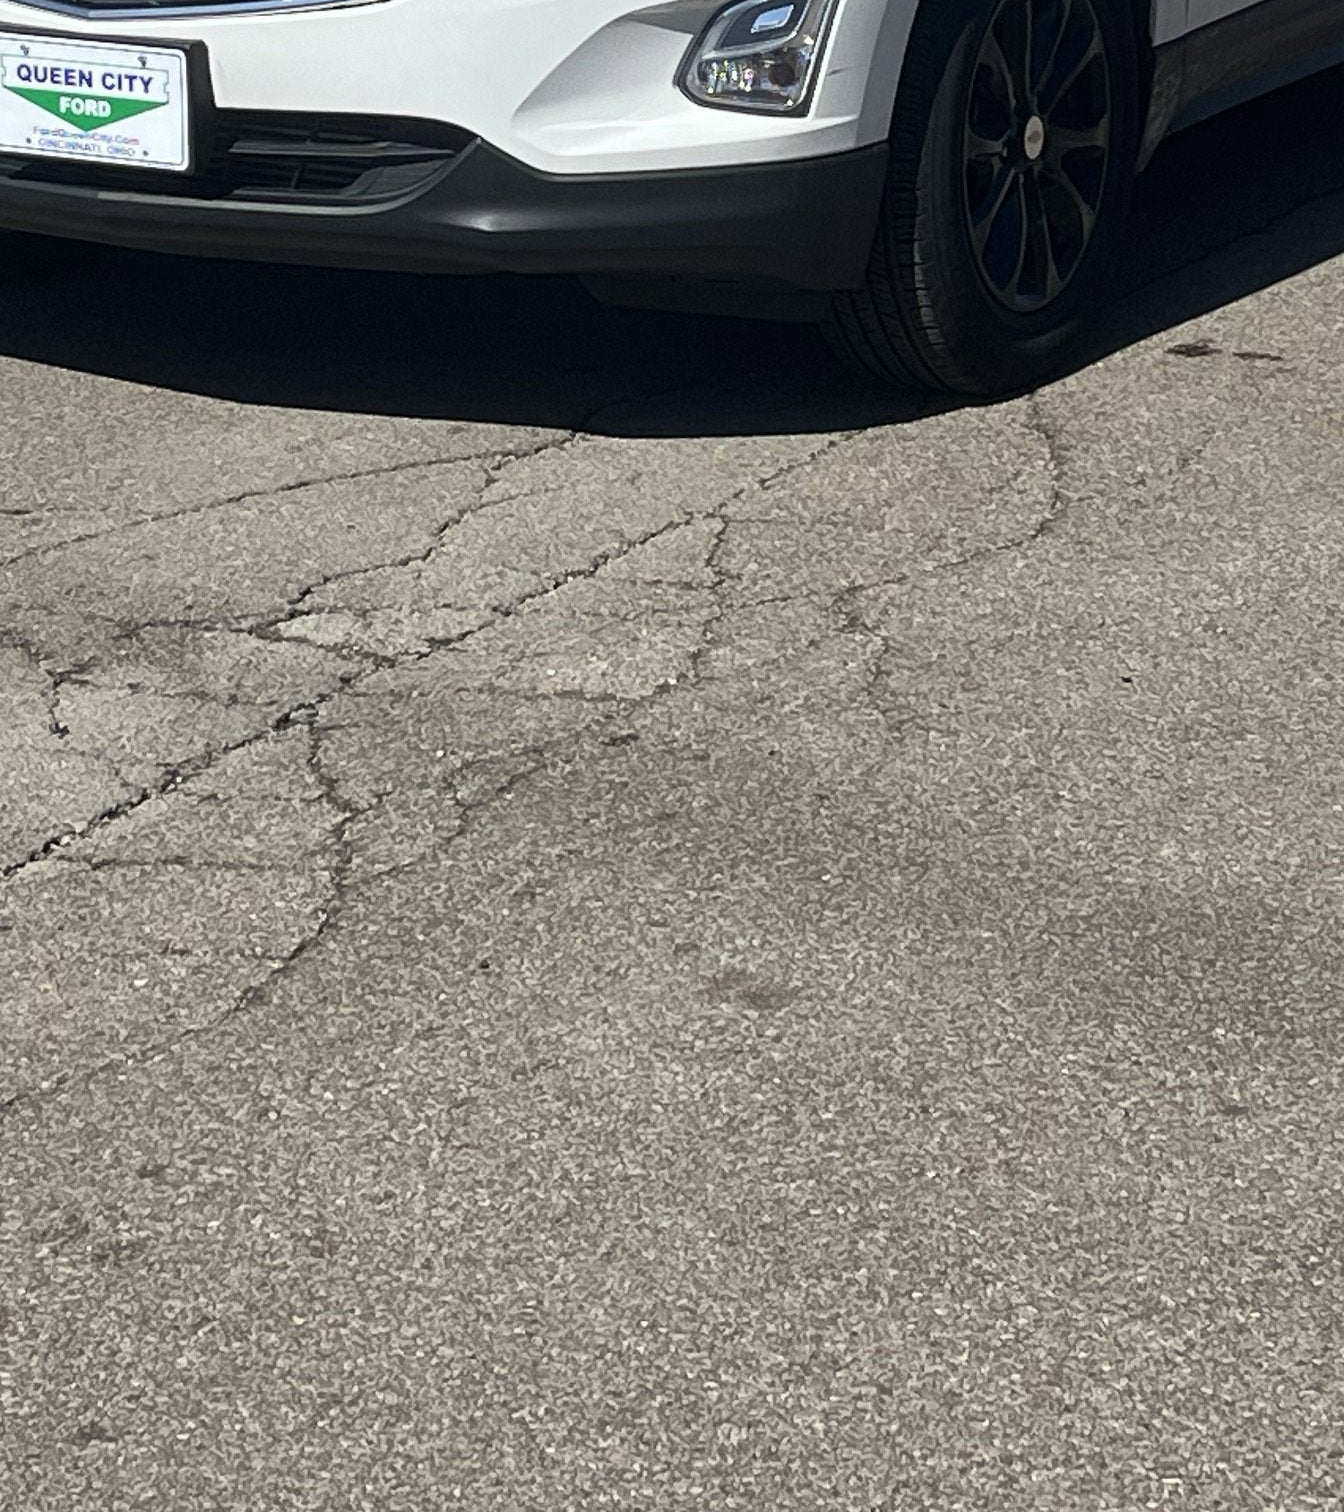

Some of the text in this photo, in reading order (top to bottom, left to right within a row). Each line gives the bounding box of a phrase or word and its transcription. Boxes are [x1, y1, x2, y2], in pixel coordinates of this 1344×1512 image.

[16, 63, 154, 94] QUEEN CITY
[58, 96, 111, 118] FORD
